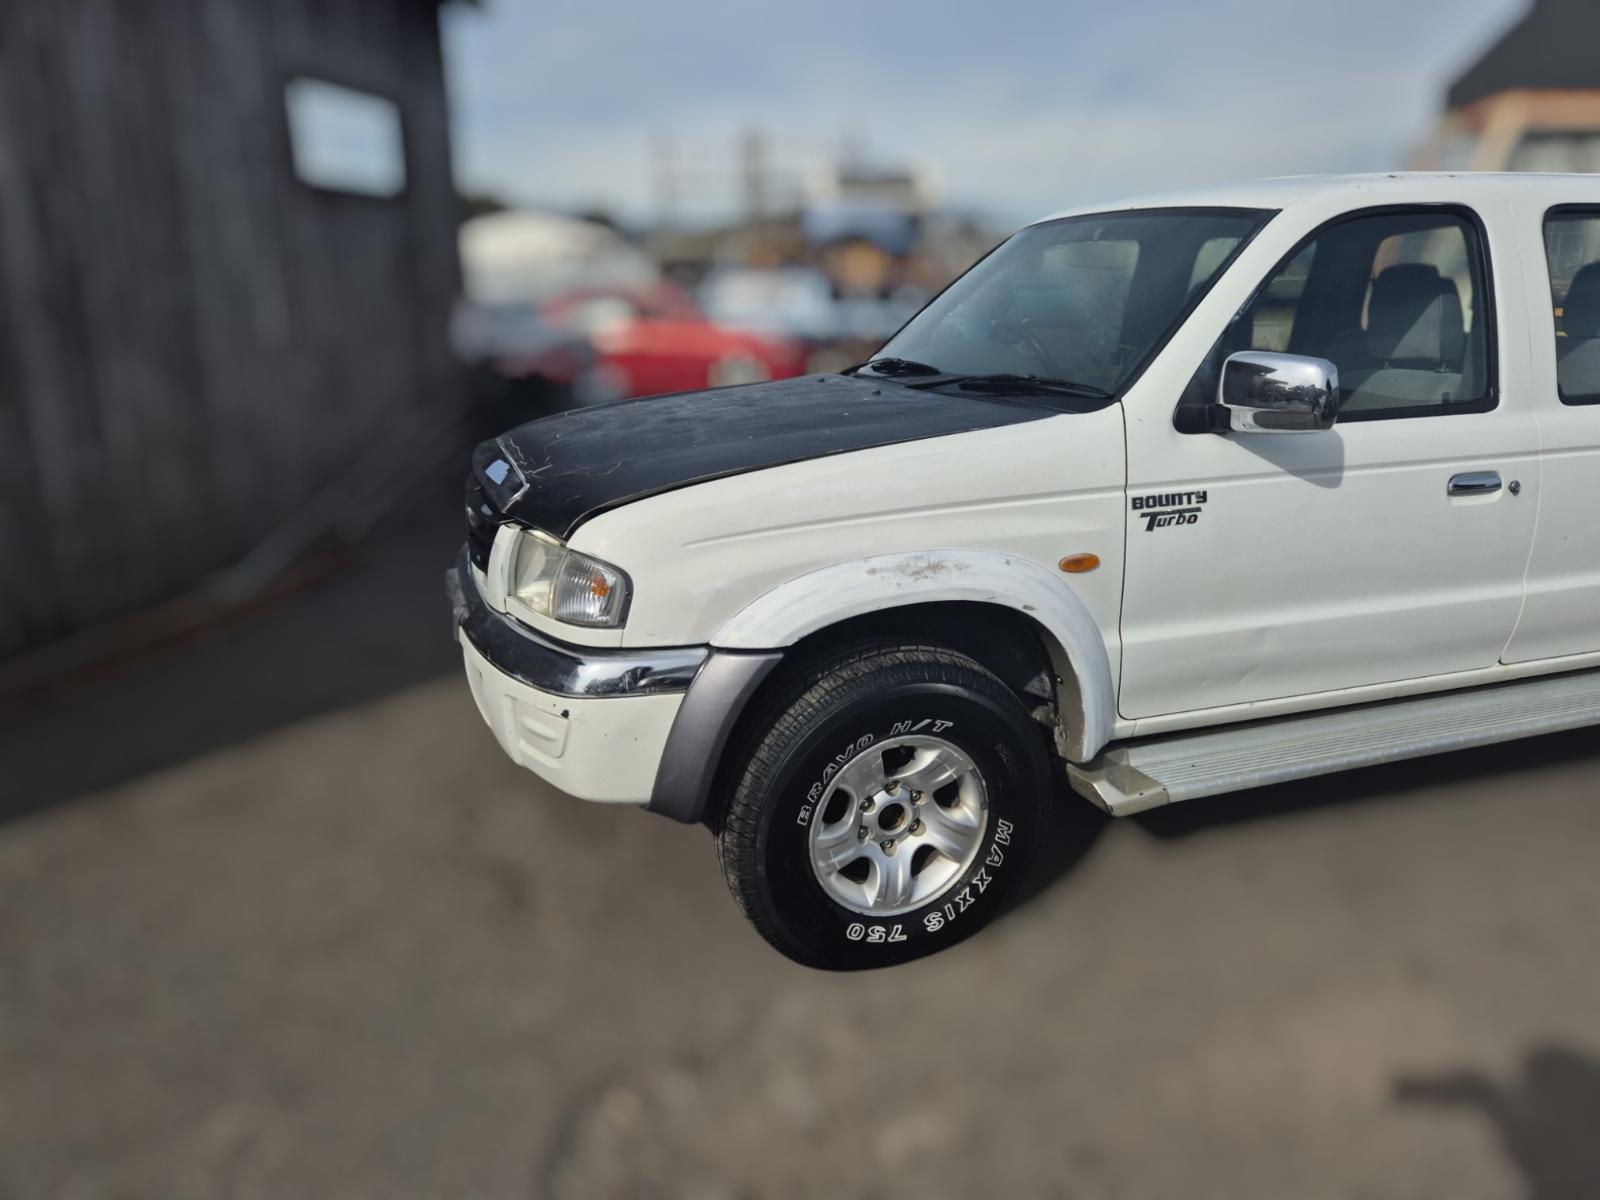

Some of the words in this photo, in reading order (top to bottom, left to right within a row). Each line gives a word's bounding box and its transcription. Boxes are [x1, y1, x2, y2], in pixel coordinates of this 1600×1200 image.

[1131, 490, 1207, 510] BOUNTY
[1139, 507, 1202, 532] Turbo
[798, 734, 873, 825] BRAVO
[891, 718, 953, 735] H/T
[923, 818, 1014, 932] MAXXIS
[846, 923, 907, 943] 750
